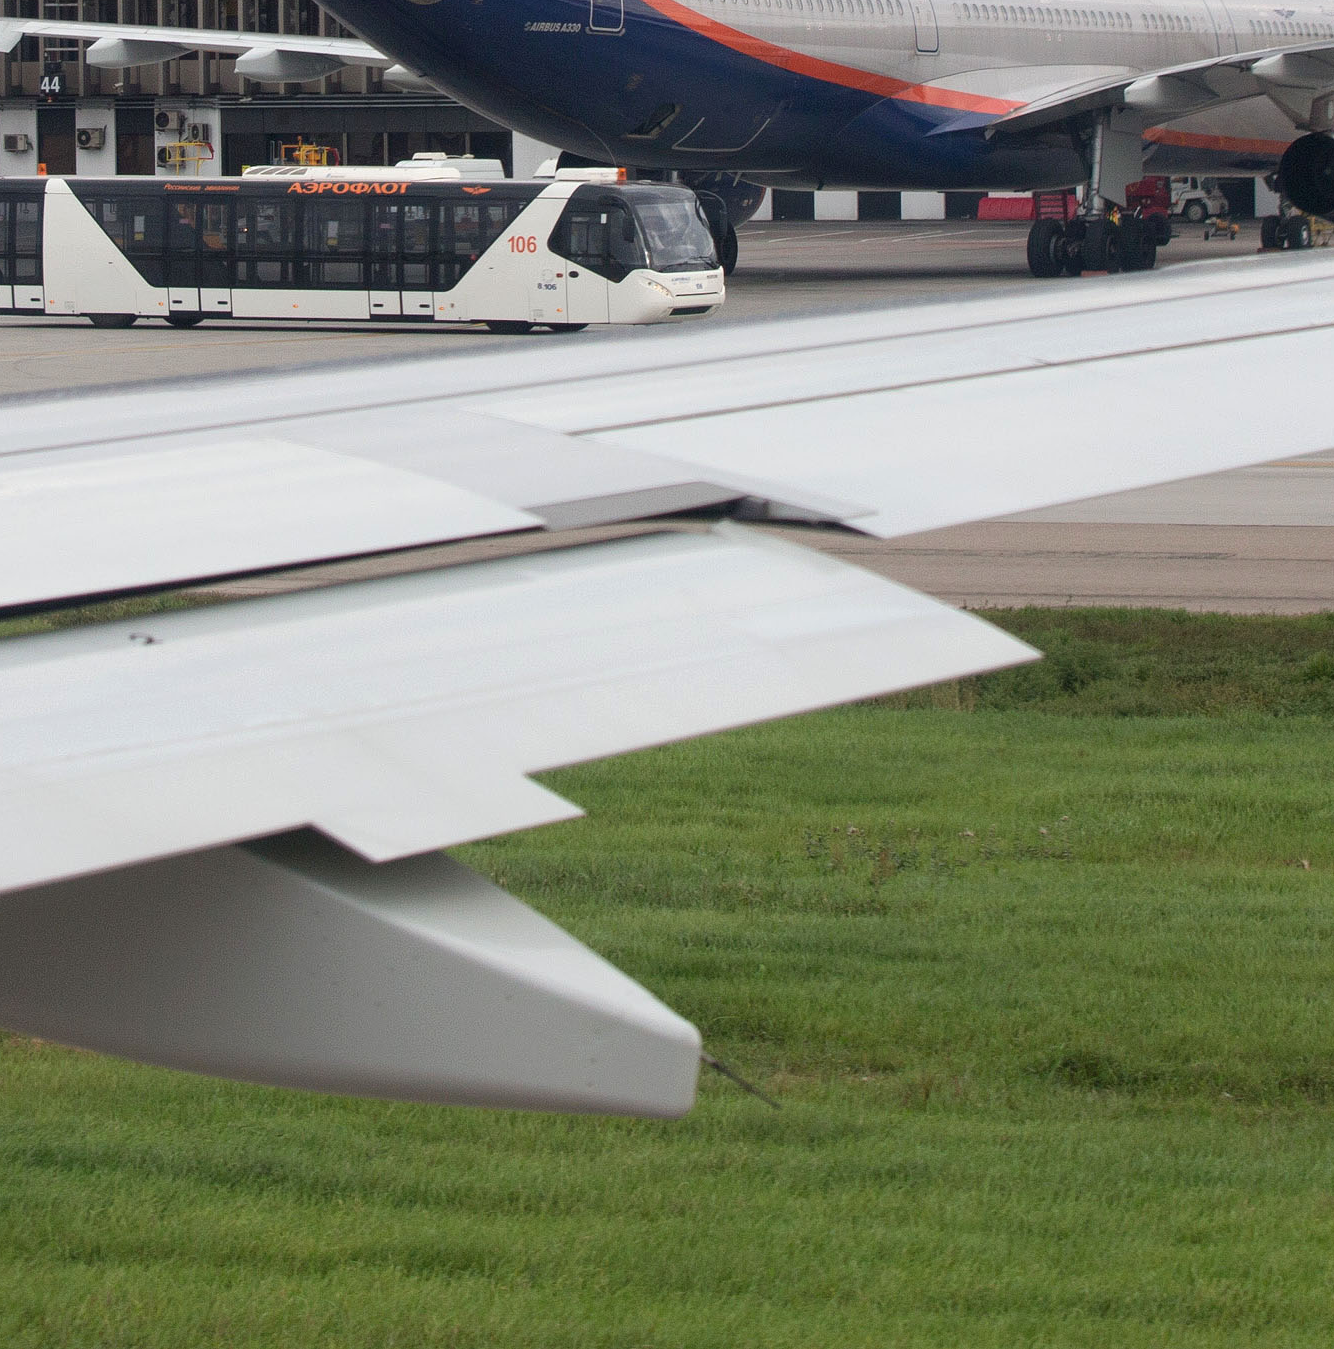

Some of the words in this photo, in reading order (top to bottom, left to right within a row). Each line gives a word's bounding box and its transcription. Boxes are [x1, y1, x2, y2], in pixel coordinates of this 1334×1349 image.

[530, 21, 561, 32] AIRBUS
[560, 22, 582, 33] A330
[40, 76, 61, 93] 44
[287, 182, 411, 195] АЭРОФЛОТ
[507, 235, 537, 253] 106
